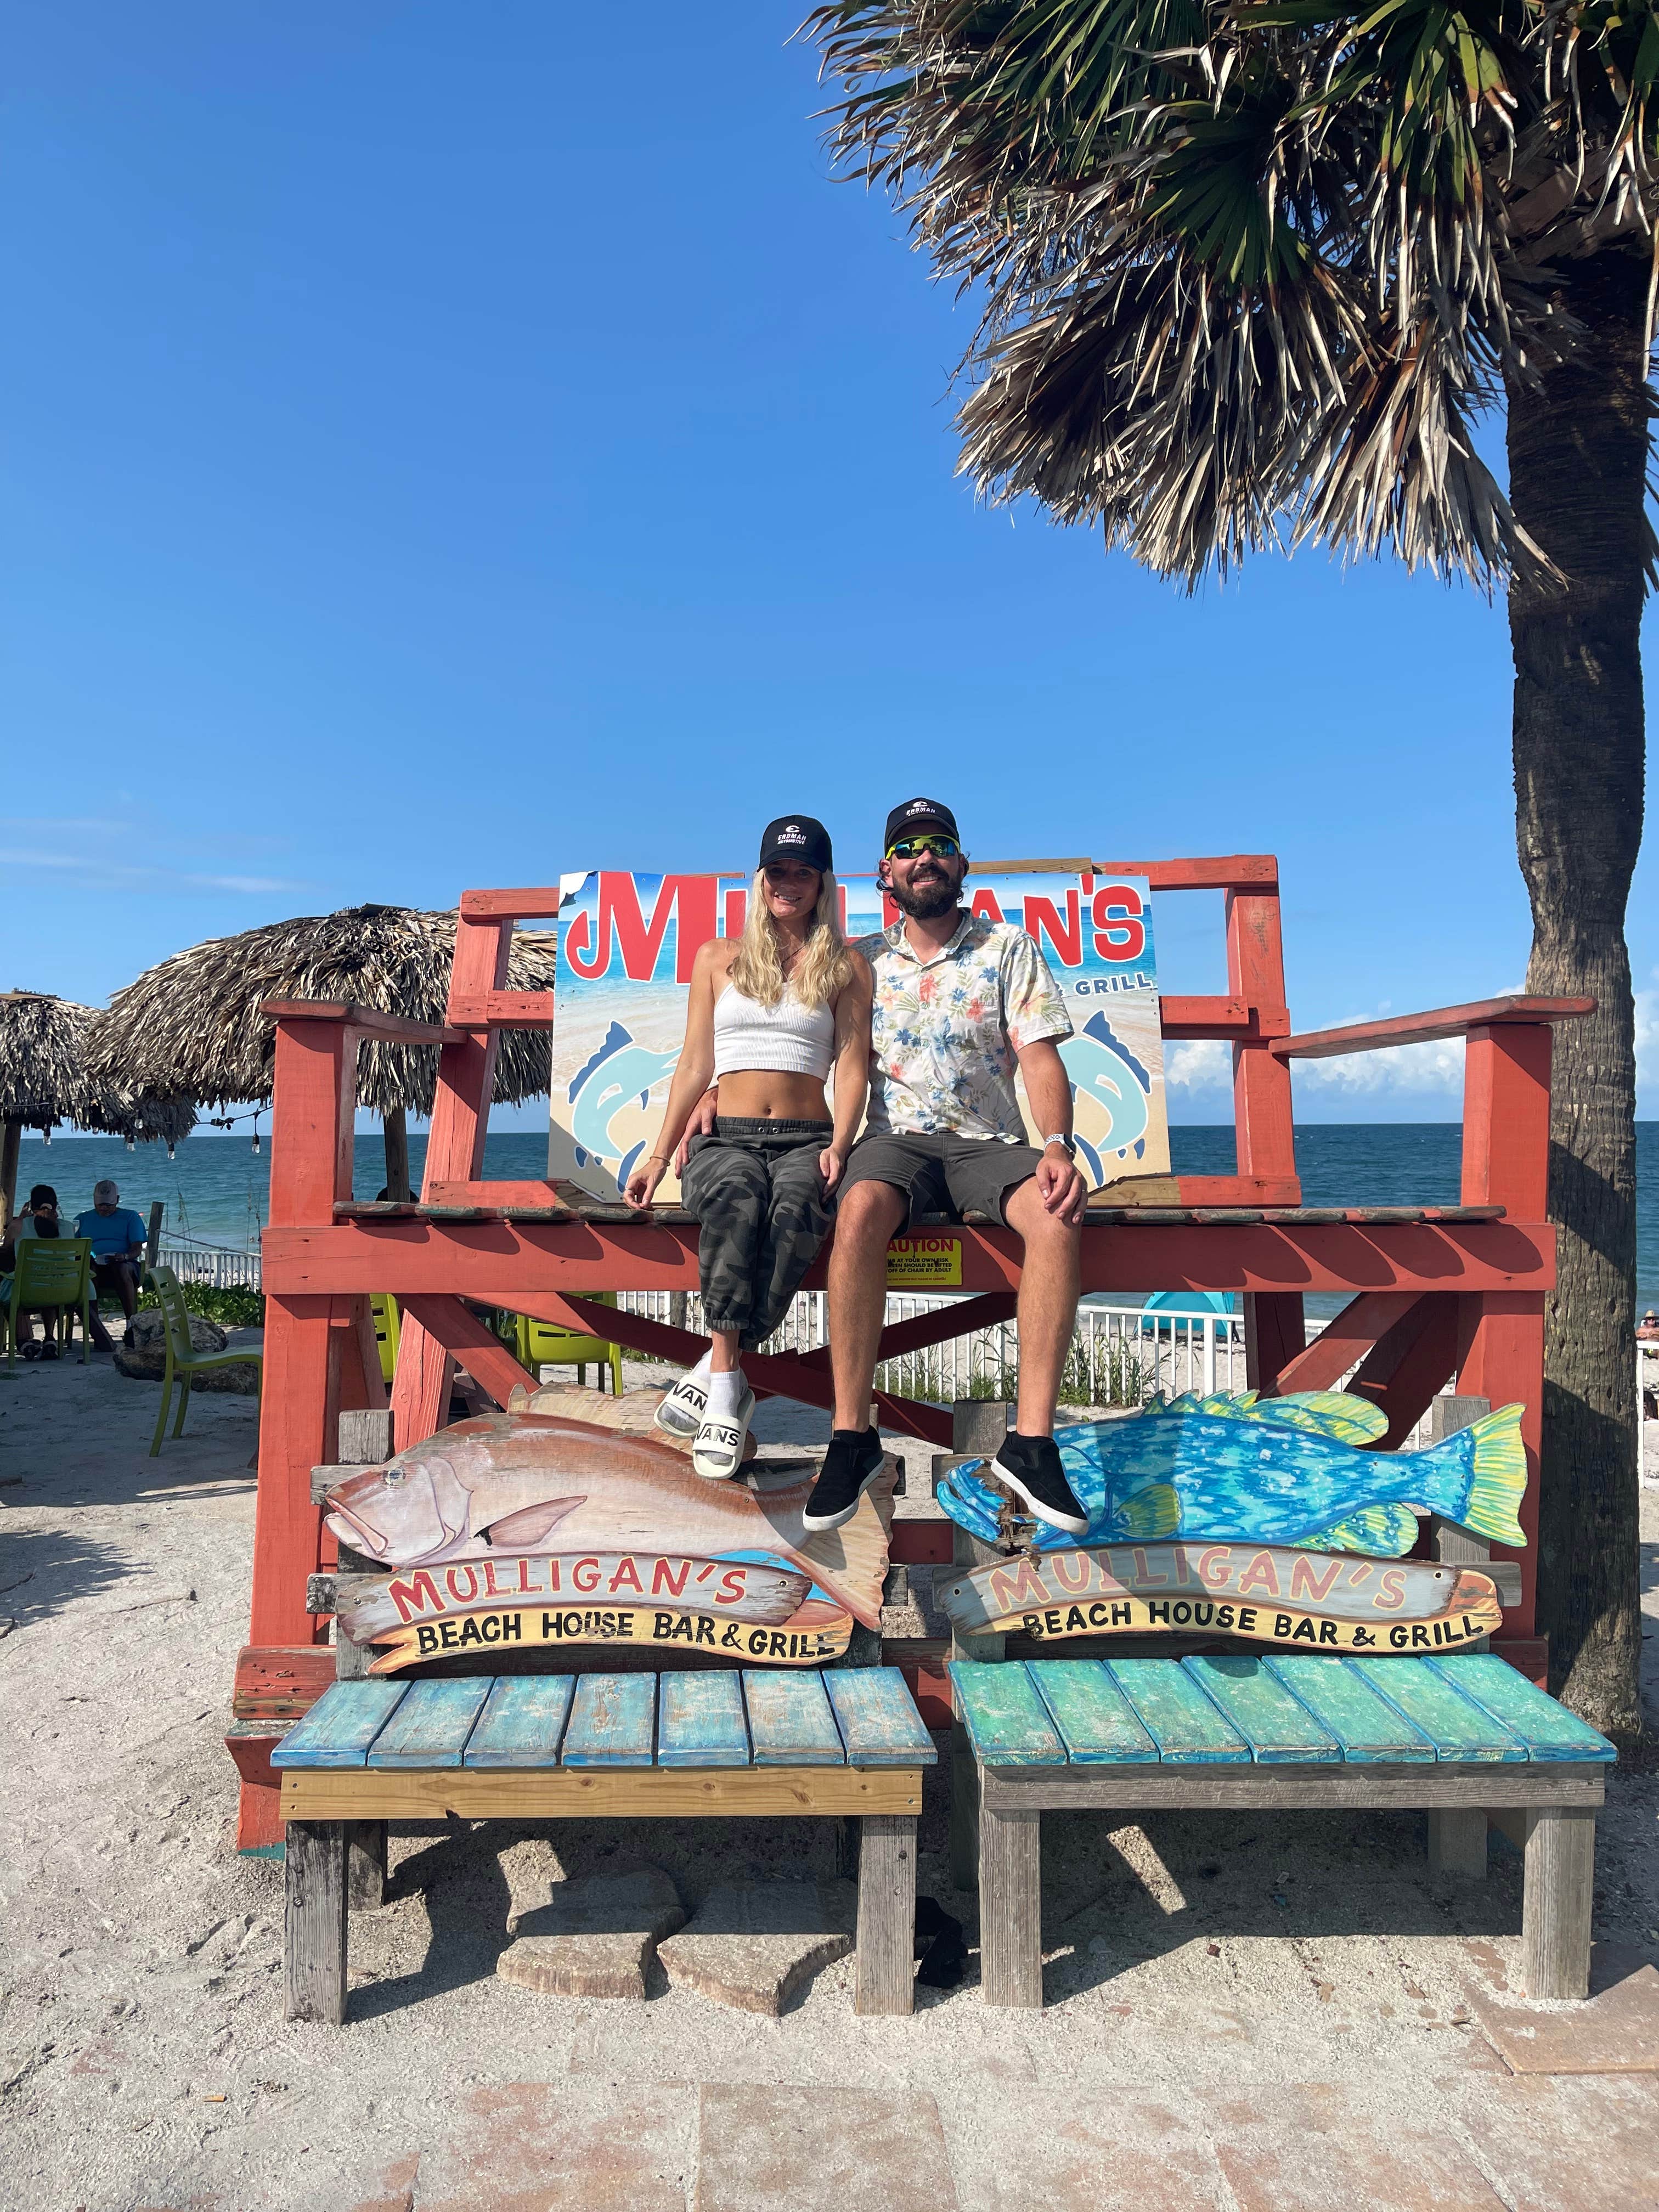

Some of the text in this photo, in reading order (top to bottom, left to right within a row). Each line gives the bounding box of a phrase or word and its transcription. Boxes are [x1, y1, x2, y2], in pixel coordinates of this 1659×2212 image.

[1075, 974, 1151, 996] GRILL
[887, 1238, 954, 1252] AUTION
[673, 1383, 708, 1411] VAN
[696, 1423, 741, 1447] VANS
[388, 1557, 747, 1624] MULLIGAN'S
[989, 1546, 1407, 1613] MULLIGAN'S
[416, 1611, 835, 1658] BEACH HOUSE BAR & GRILL
[1023, 1601, 1484, 1648] BEACH HOUSE BAR & GRILL
